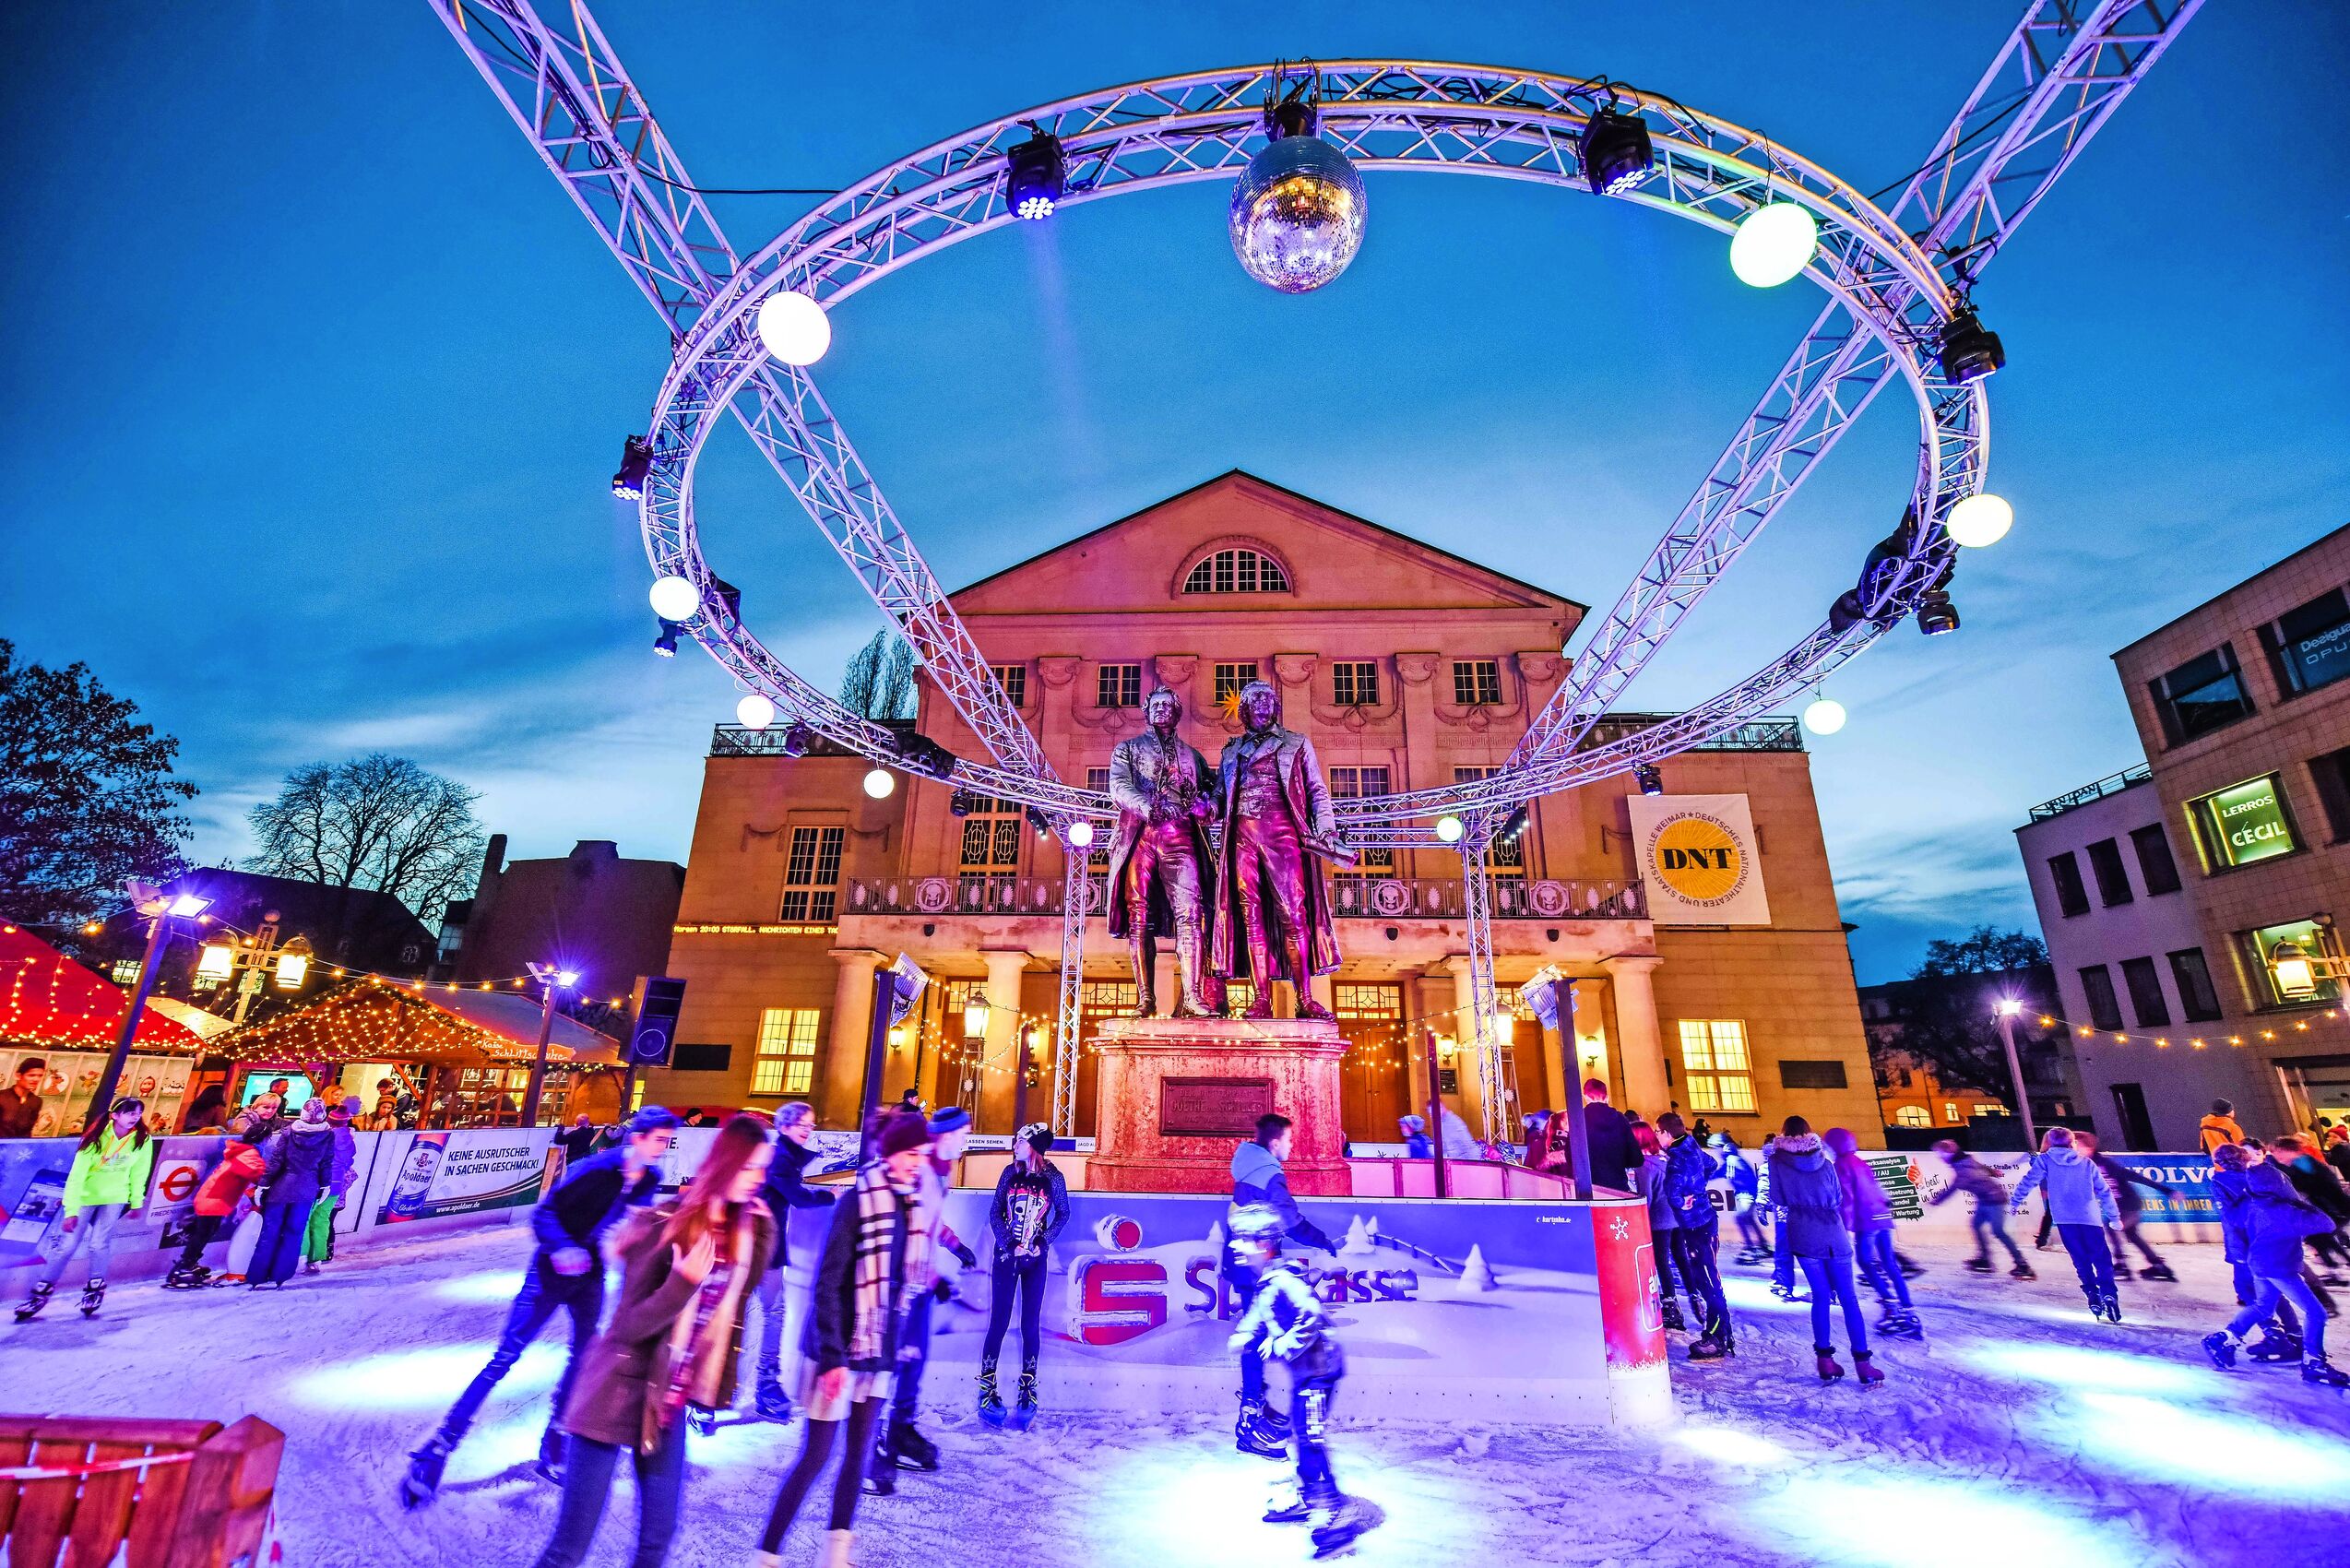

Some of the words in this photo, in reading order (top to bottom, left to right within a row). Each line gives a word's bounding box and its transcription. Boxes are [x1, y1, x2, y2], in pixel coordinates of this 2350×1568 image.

[2300, 623, 2350, 652] Desigua
[2306, 641, 2348, 664] OPU
[2222, 795, 2274, 818] LERROS
[1655, 812, 1687, 833] WEIMAR
[1695, 812, 1743, 848] DEUTSCHES
[1646, 832, 1677, 897] STAATSKAPELLE
[1661, 848, 1733, 870] DNT
[1702, 849, 1750, 909] NATIONALTHEATER
[1679, 895, 1700, 908] UND
[700, 925, 719, 933] 20:00
[759, 926, 802, 934] NACHRICHTEN
[804, 926, 825, 934] EINES
[1171, 1100, 1205, 1113] GOETHE
[447, 1149, 474, 1162] KEINE
[474, 1146, 530, 1160] AUSRUTSCHER
[444, 1165, 455, 1177] IN
[456, 1162, 490, 1176] SACHEN
[491, 1158, 540, 1172] GESCHMACK!
[401, 1170, 432, 1183] Apoldaer
[1878, 1180, 1896, 1189] gnose
[1924, 1173, 1941, 1189] best
[1888, 1188, 1915, 1196] dsetzung
[1921, 1194, 1930, 1203] in
[436, 1201, 481, 1213] www.apoldaer.de
[1895, 1208, 1920, 1217] Wartung
[1184, 1255, 1418, 1320] Spasse
